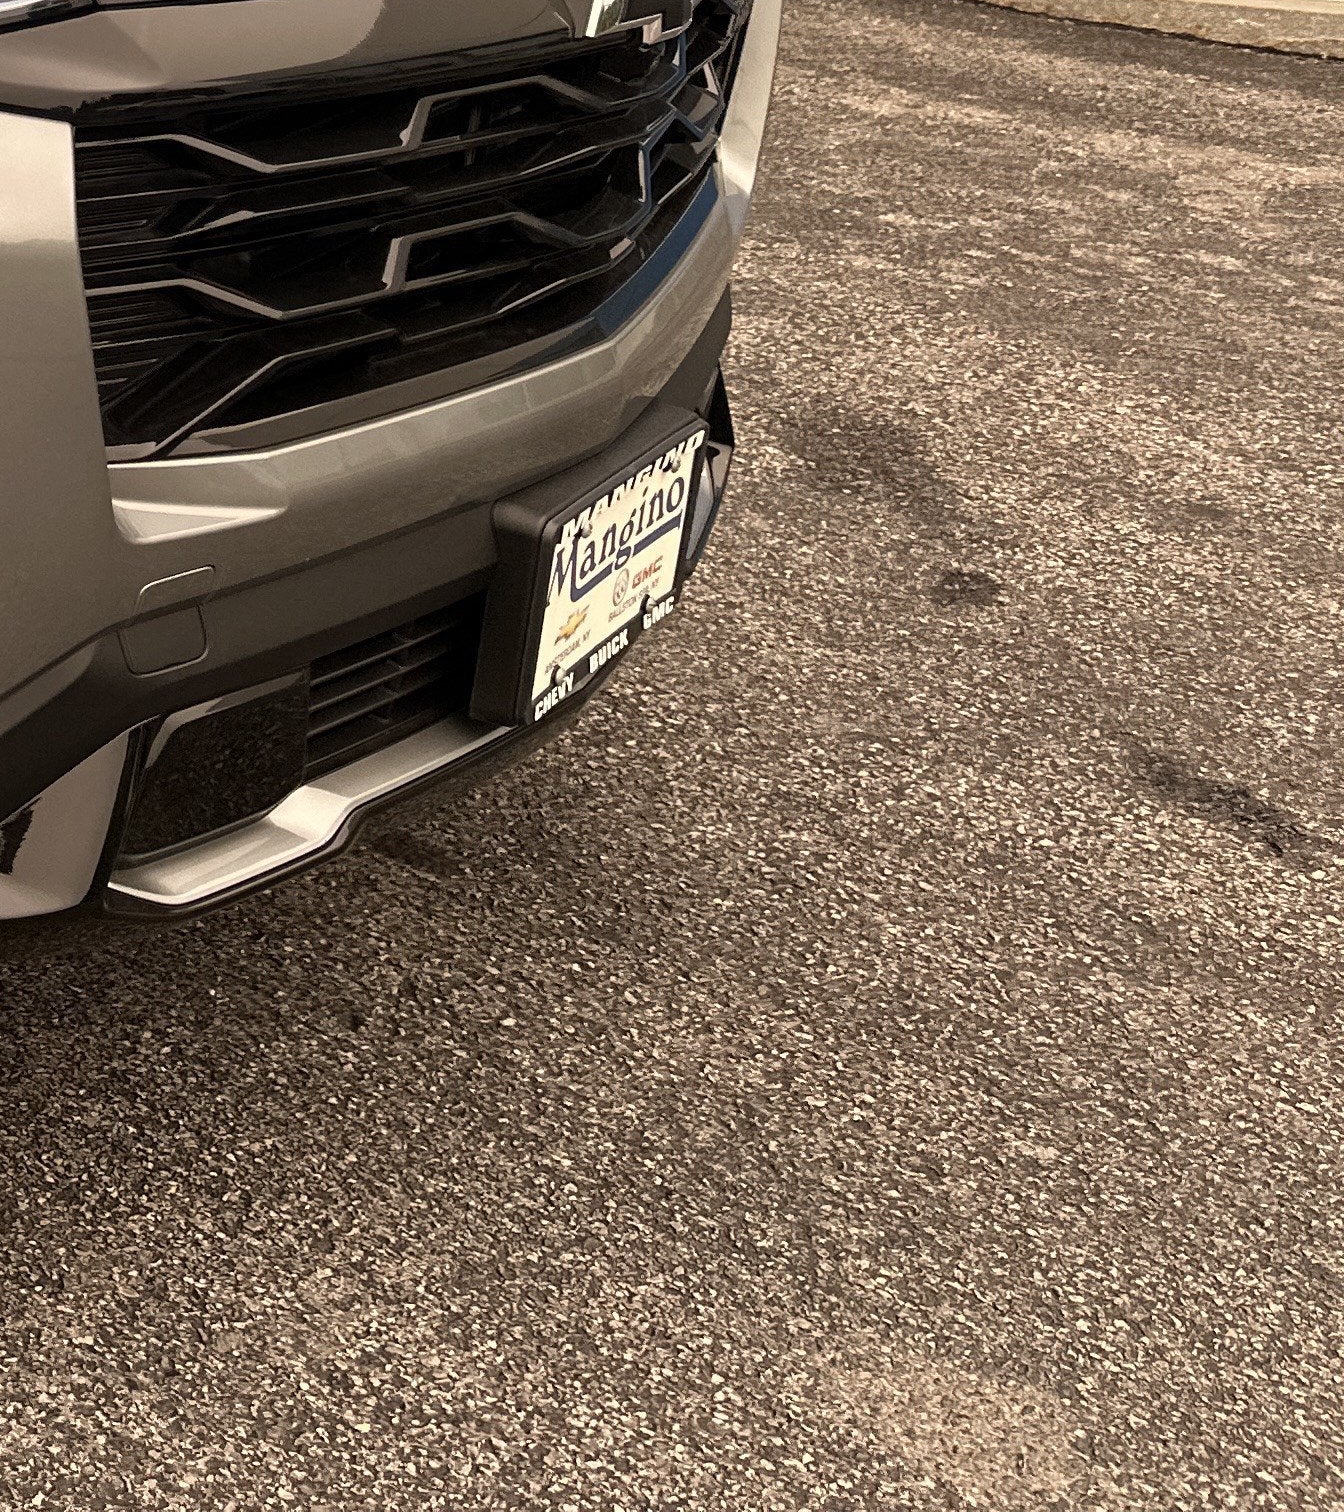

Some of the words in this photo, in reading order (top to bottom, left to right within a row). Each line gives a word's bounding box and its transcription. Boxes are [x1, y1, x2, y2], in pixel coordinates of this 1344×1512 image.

[548, 476, 686, 602] Mangino
[632, 555, 664, 589] GMC
[534, 671, 574, 722] CHEVY
[589, 628, 629, 674] BUICK
[642, 595, 675, 630] GMC
